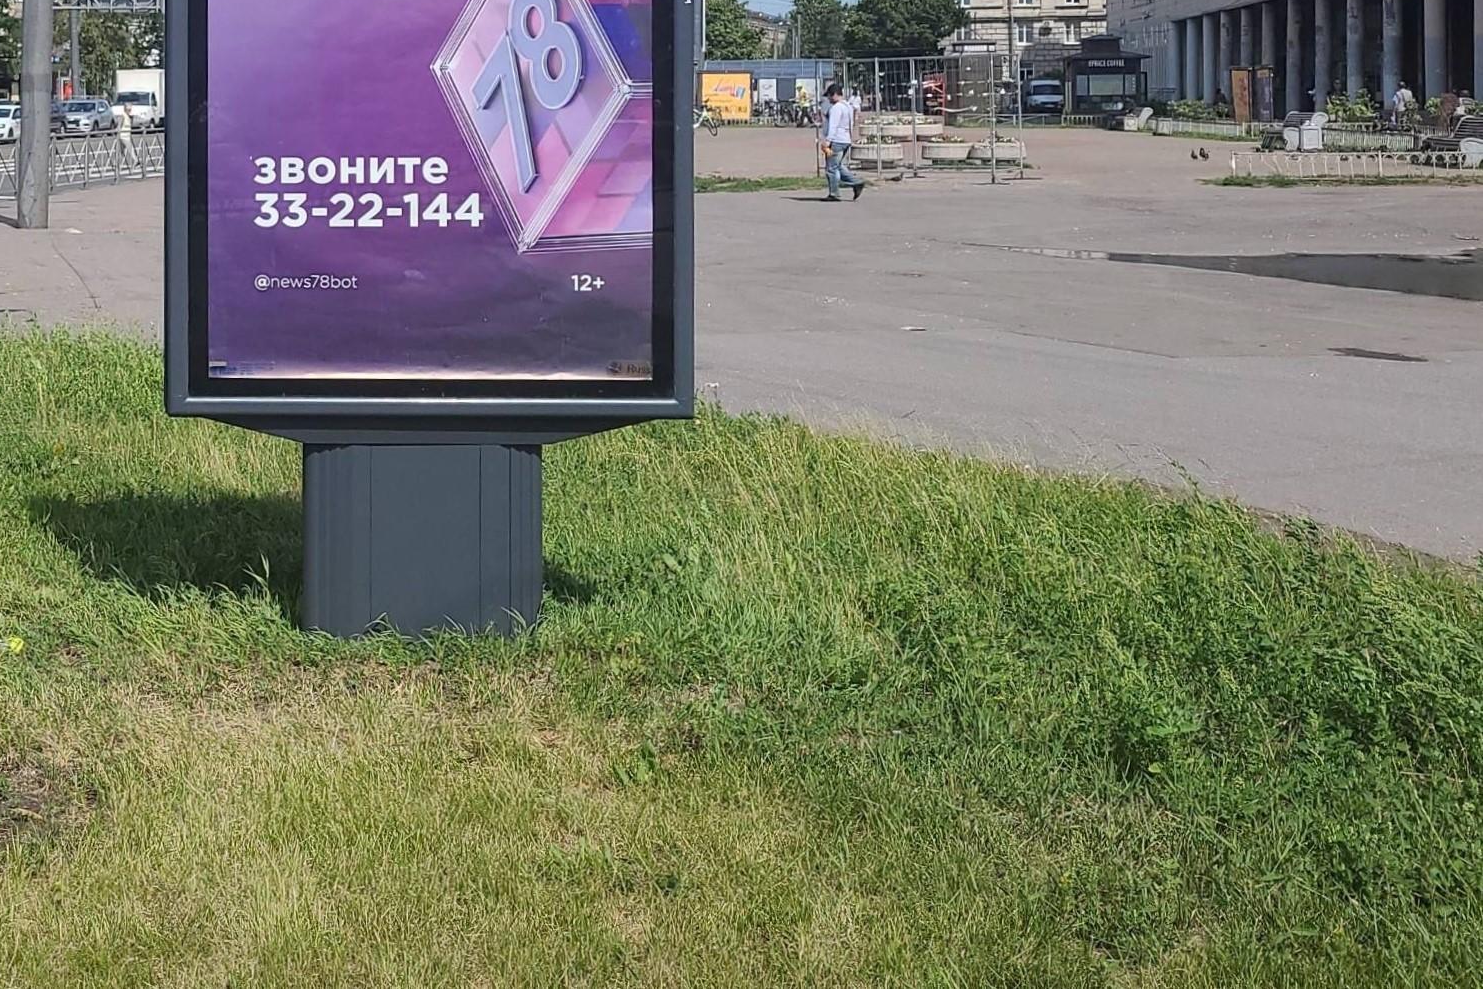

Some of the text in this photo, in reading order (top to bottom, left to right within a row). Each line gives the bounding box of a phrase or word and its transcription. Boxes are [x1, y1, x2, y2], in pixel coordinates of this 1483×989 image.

[253, 156, 449, 185] звоните
[253, 192, 485, 228] 33-22-144
[253, 274, 359, 291] @news78bot
[570, 274, 606, 292] 12+
